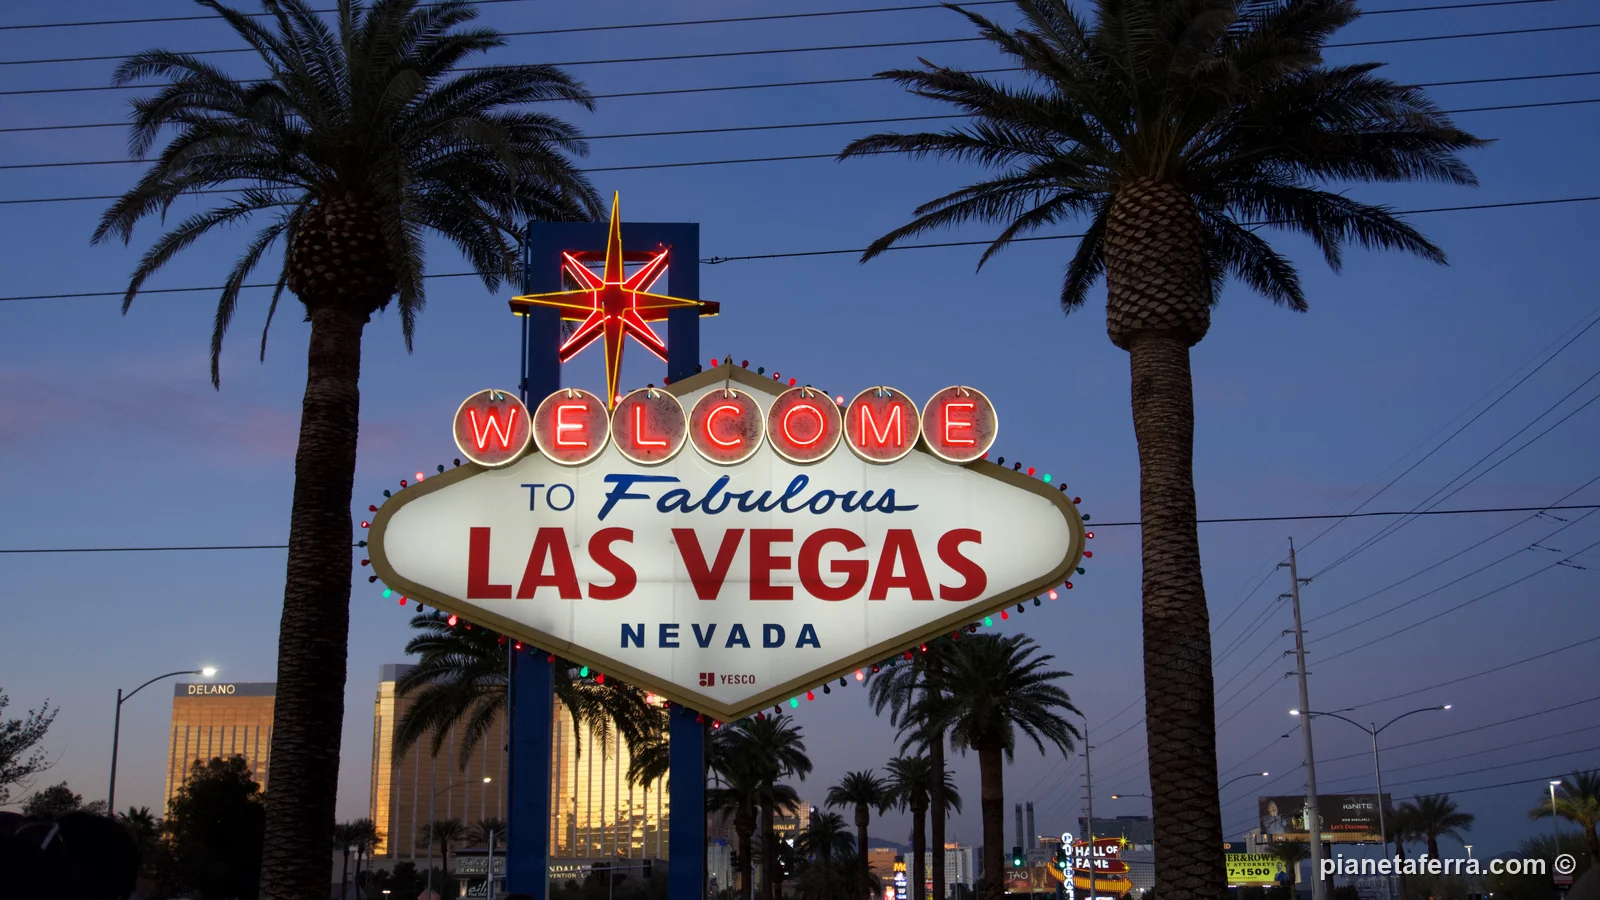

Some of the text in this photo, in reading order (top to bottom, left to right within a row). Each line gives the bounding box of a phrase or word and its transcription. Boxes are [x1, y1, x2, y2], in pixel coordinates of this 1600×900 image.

[465, 401, 979, 451] WELCOME
[521, 474, 918, 521] TO Fabulous
[468, 528, 987, 601] LAS VEGAS
[621, 624, 821, 648] NEVADA
[720, 675, 755, 684] YESCO
[188, 684, 235, 694] DELANO
[1075, 845, 1118, 857] HALL OF
[1076, 858, 1109, 868] FAME
[1006, 871, 1029, 880] TAO
